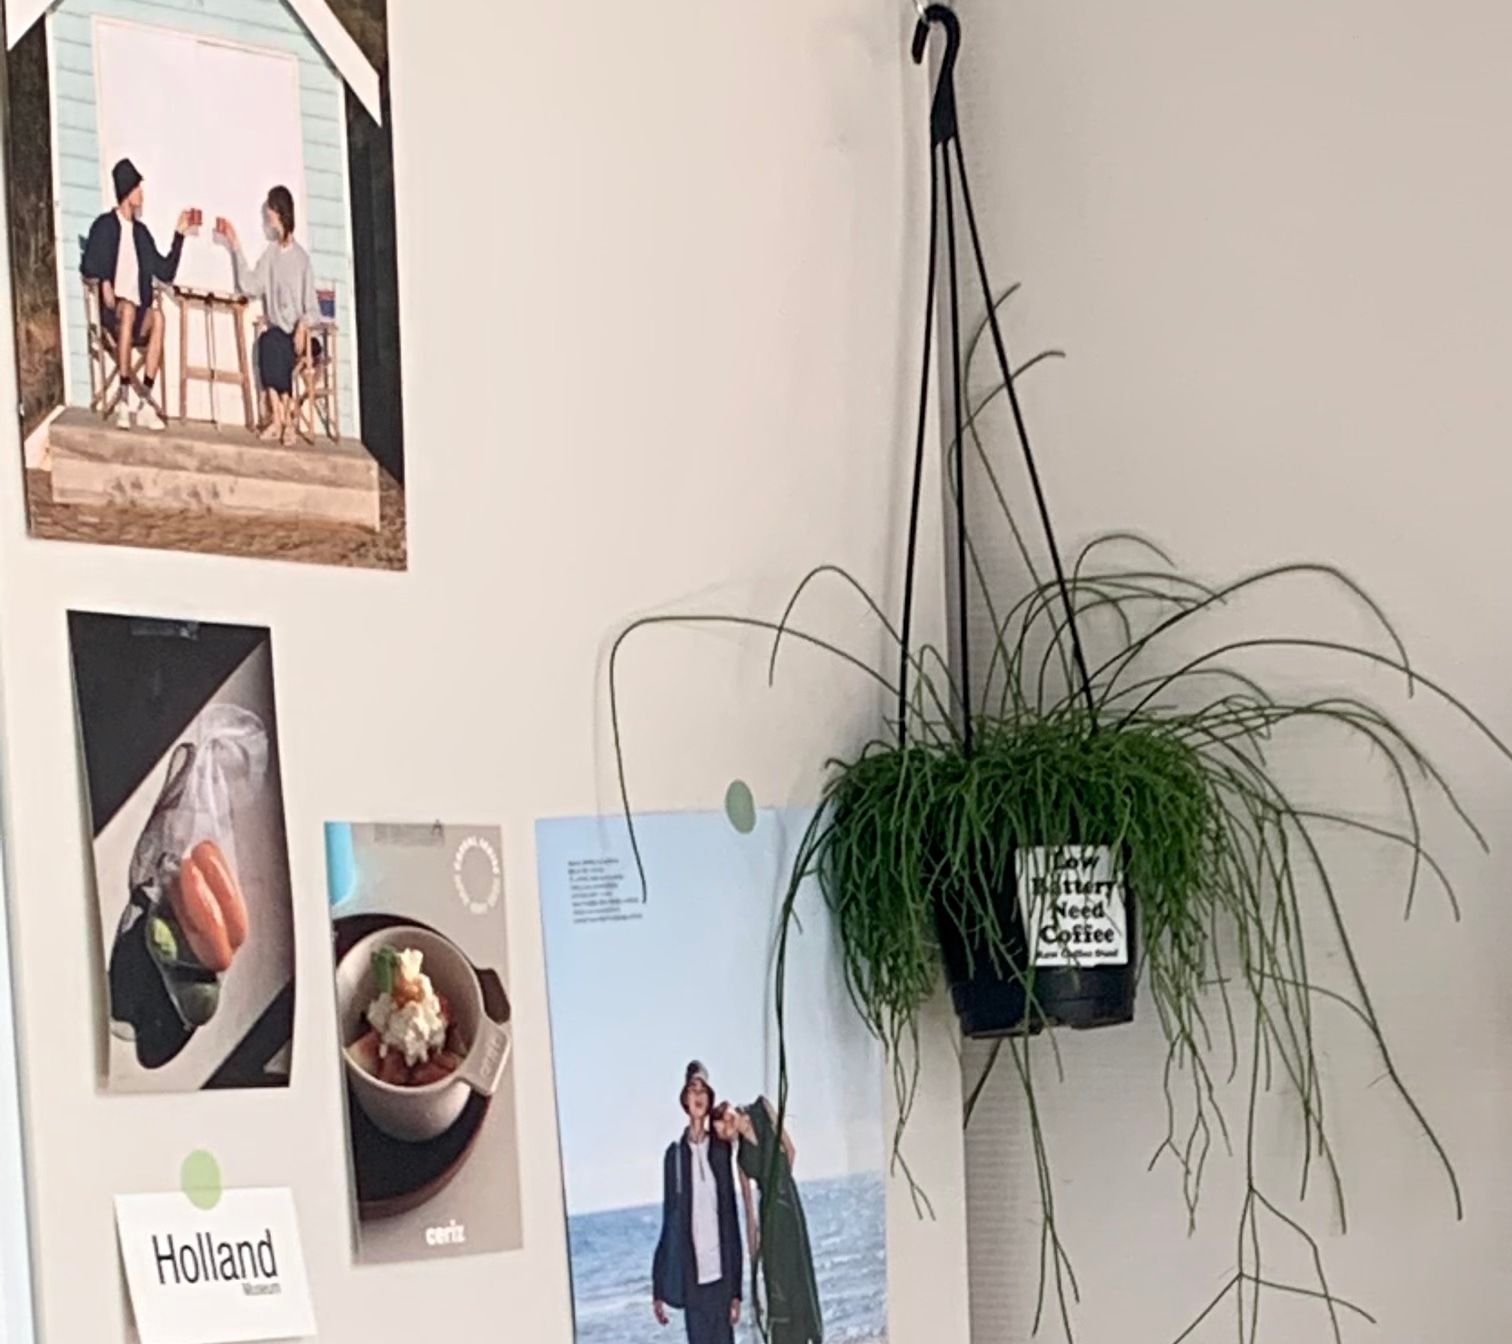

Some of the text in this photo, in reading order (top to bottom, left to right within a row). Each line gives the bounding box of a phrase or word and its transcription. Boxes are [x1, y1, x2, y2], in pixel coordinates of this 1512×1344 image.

[1053, 902, 1105, 920] Need
[1039, 924, 1115, 944] Coffee
[151, 1228, 279, 1285] Holland
